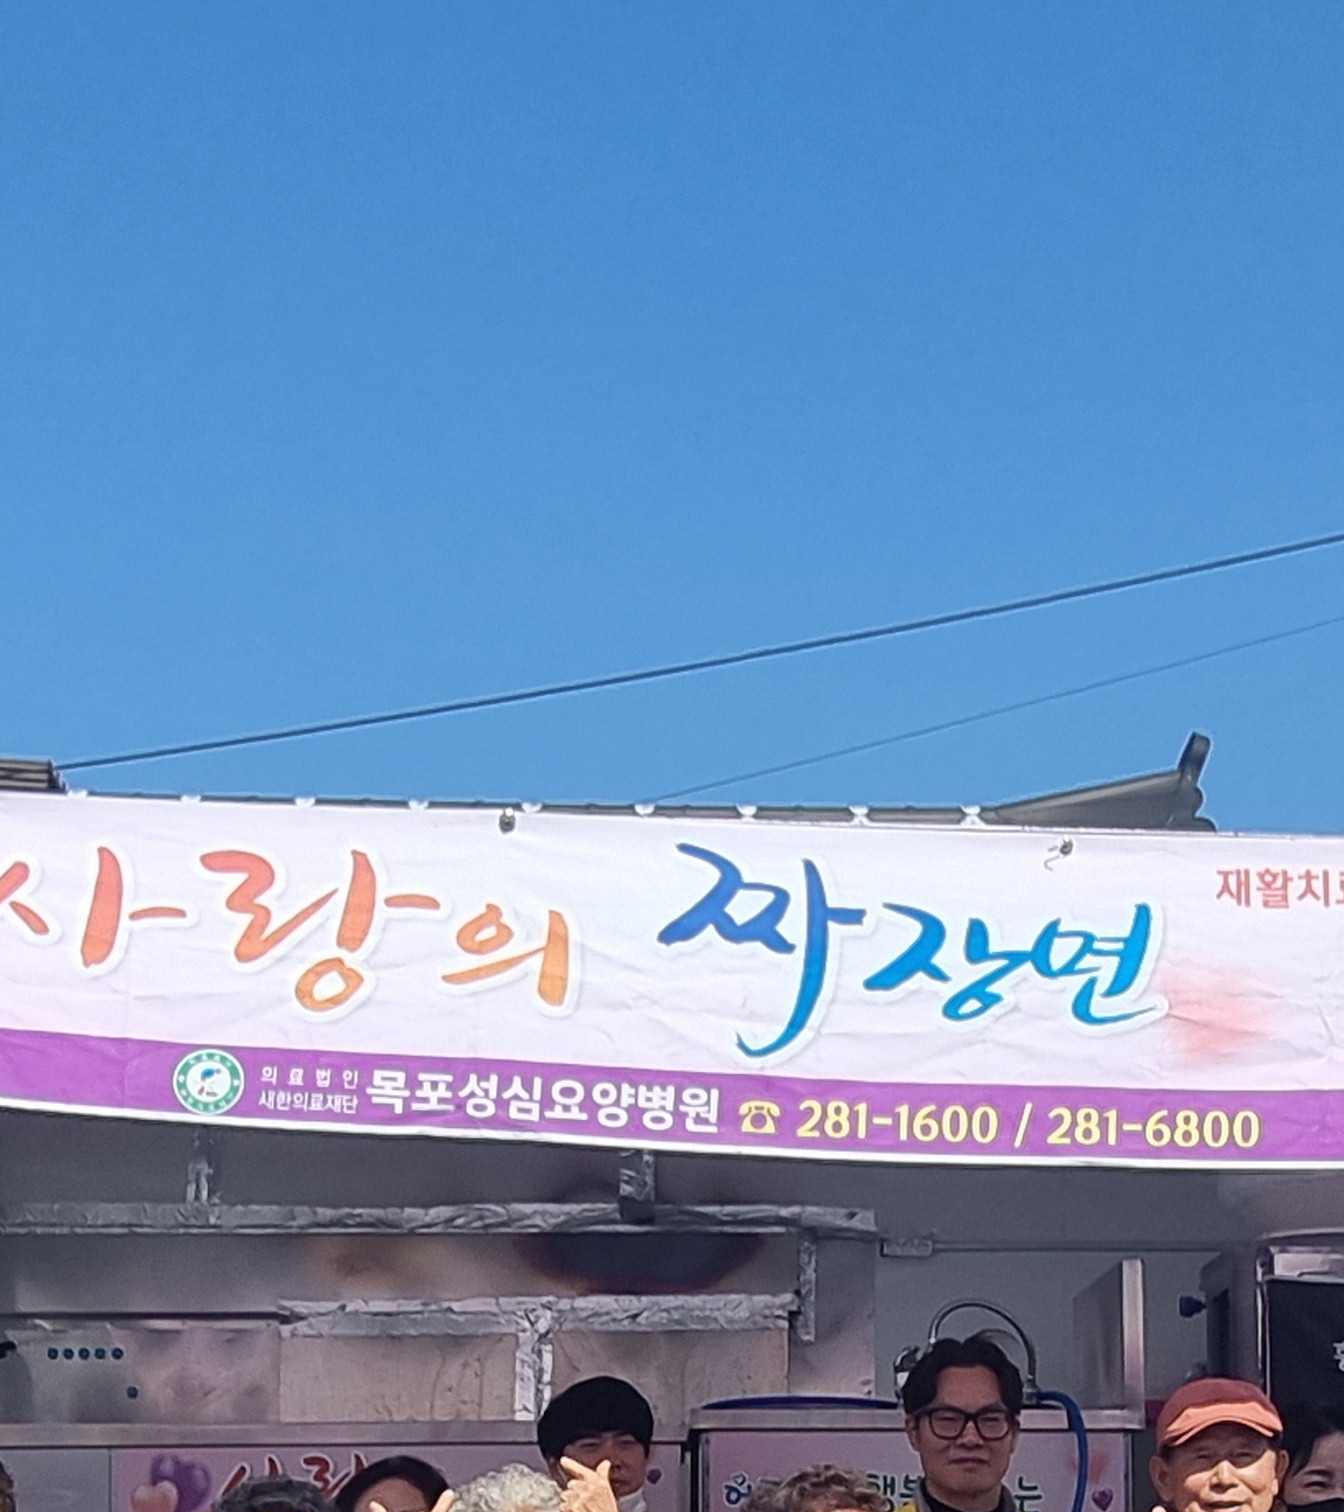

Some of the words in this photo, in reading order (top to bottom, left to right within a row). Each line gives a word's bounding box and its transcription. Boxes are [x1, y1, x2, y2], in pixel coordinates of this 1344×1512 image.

[657, 843, 1158, 1059] 짜장면
[258, 1089, 359, 1115] 새한의료재단
[366, 1067, 721, 1133] 목포성심요양병원
[795, 1100, 1000, 1144] 281-1600
[1047, 1105, 1262, 1149] 281-6800
